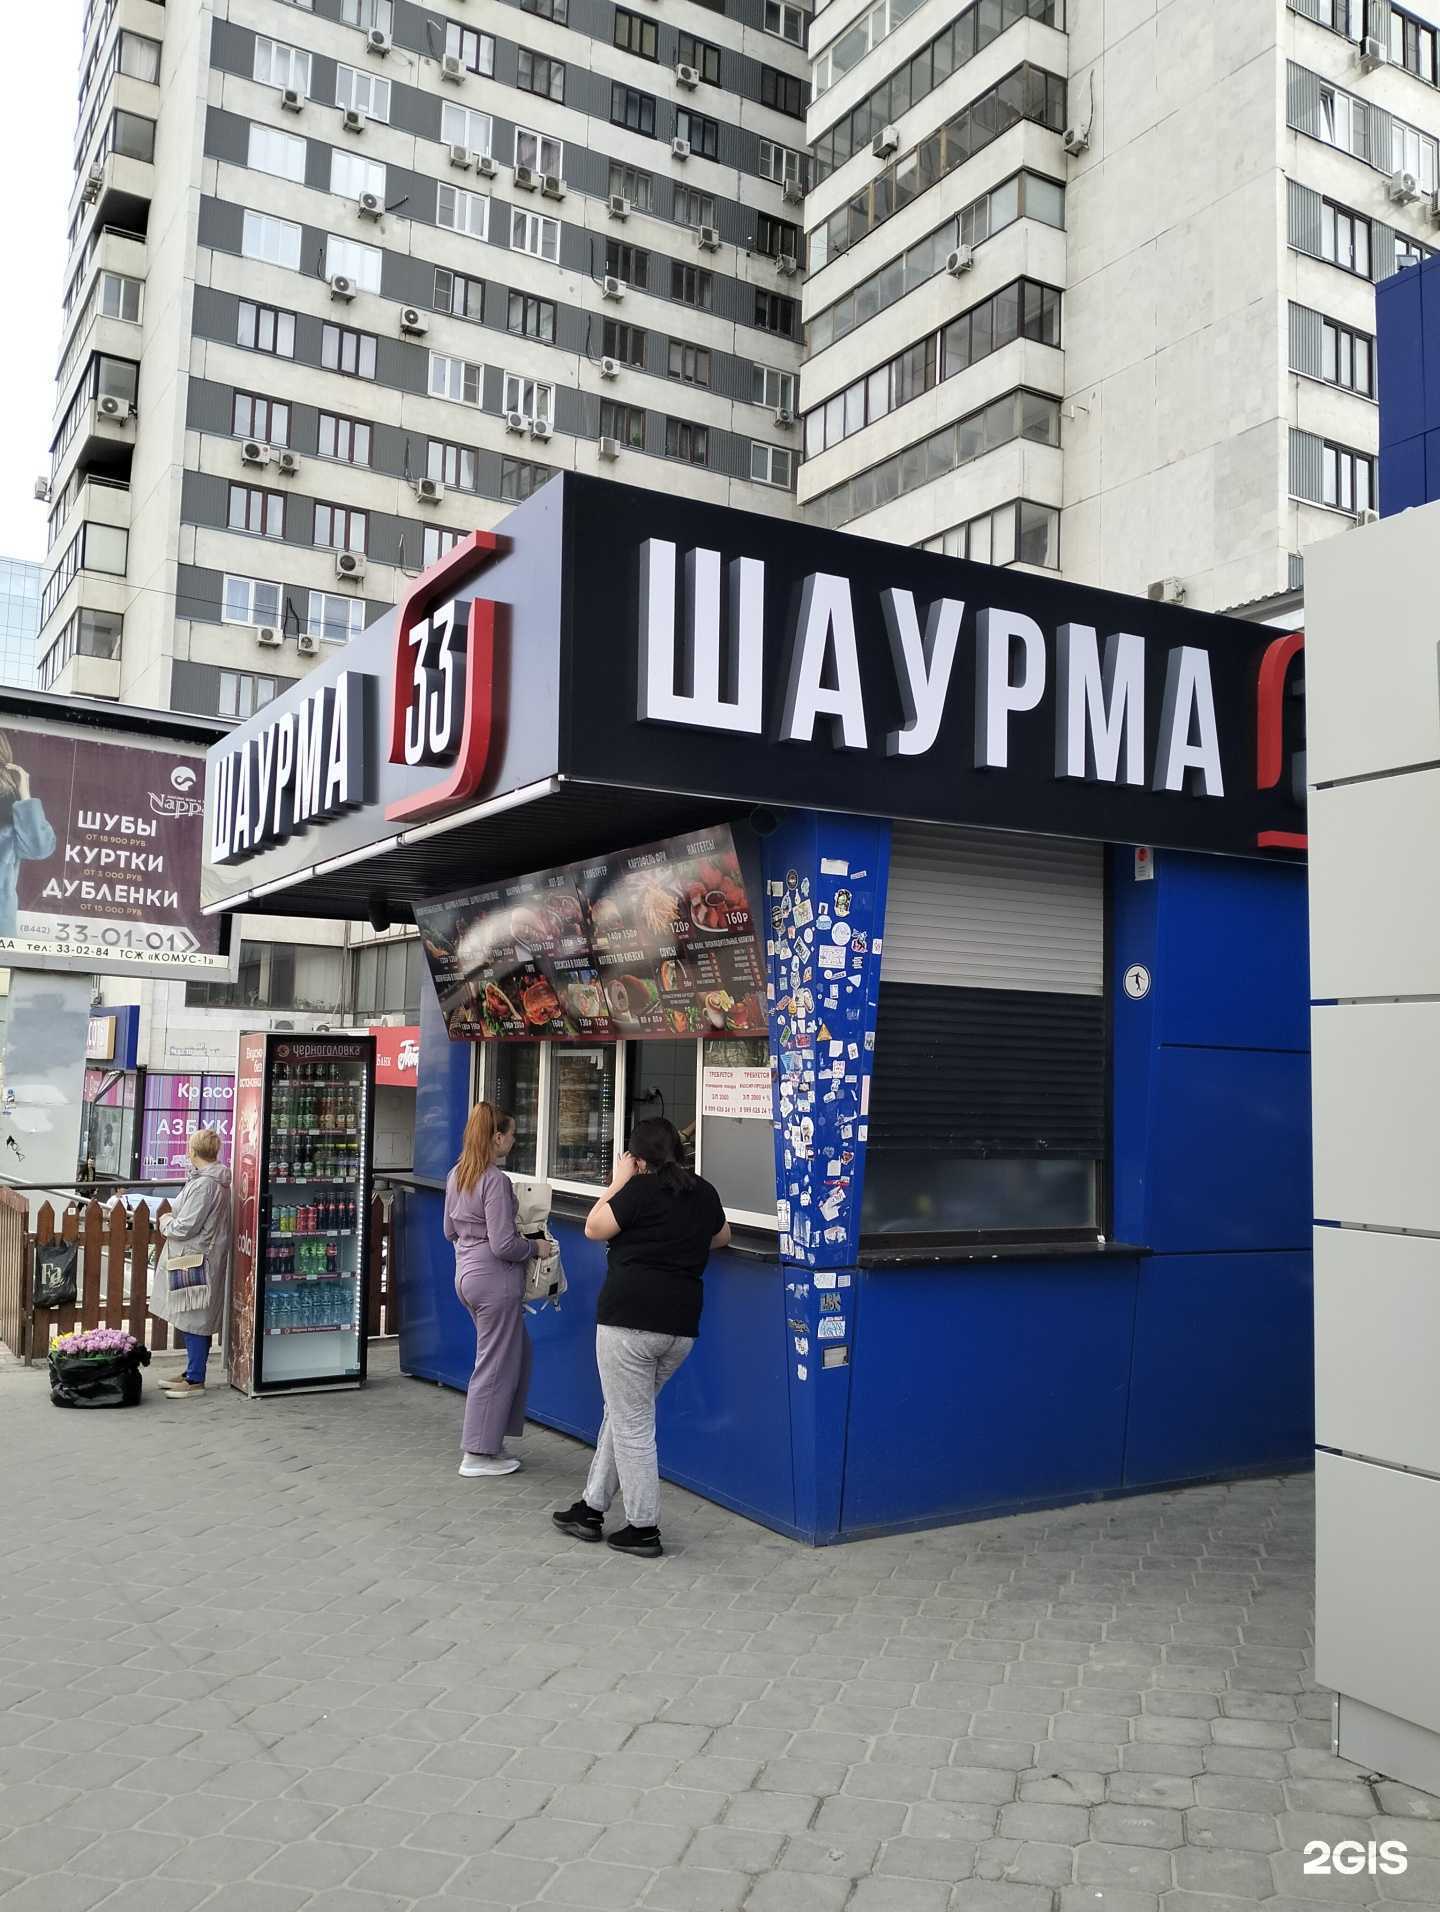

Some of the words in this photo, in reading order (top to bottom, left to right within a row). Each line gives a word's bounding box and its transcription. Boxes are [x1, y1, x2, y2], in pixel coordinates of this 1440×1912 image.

[638, 537, 1225, 798] ШАУРМА
[404, 599, 458, 766] 33
[210, 670, 355, 864] ШАУРМА
[147, 791, 205, 819] Napp
[77, 810, 157, 837] ШУБЫ
[129, 839, 146, 847] РУБ
[65, 844, 164, 873] КУРТКИ
[42, 877, 178, 909] ДУБЛЕНКИ
[55, 922, 176, 951] 33-01-01
[56, 943, 109, 957] 33-02-84
[119, 950, 144, 961] ТСЖ
[177, 1083, 236, 1101] Красо
[157, 1118, 233, 1136] АЗБУК
